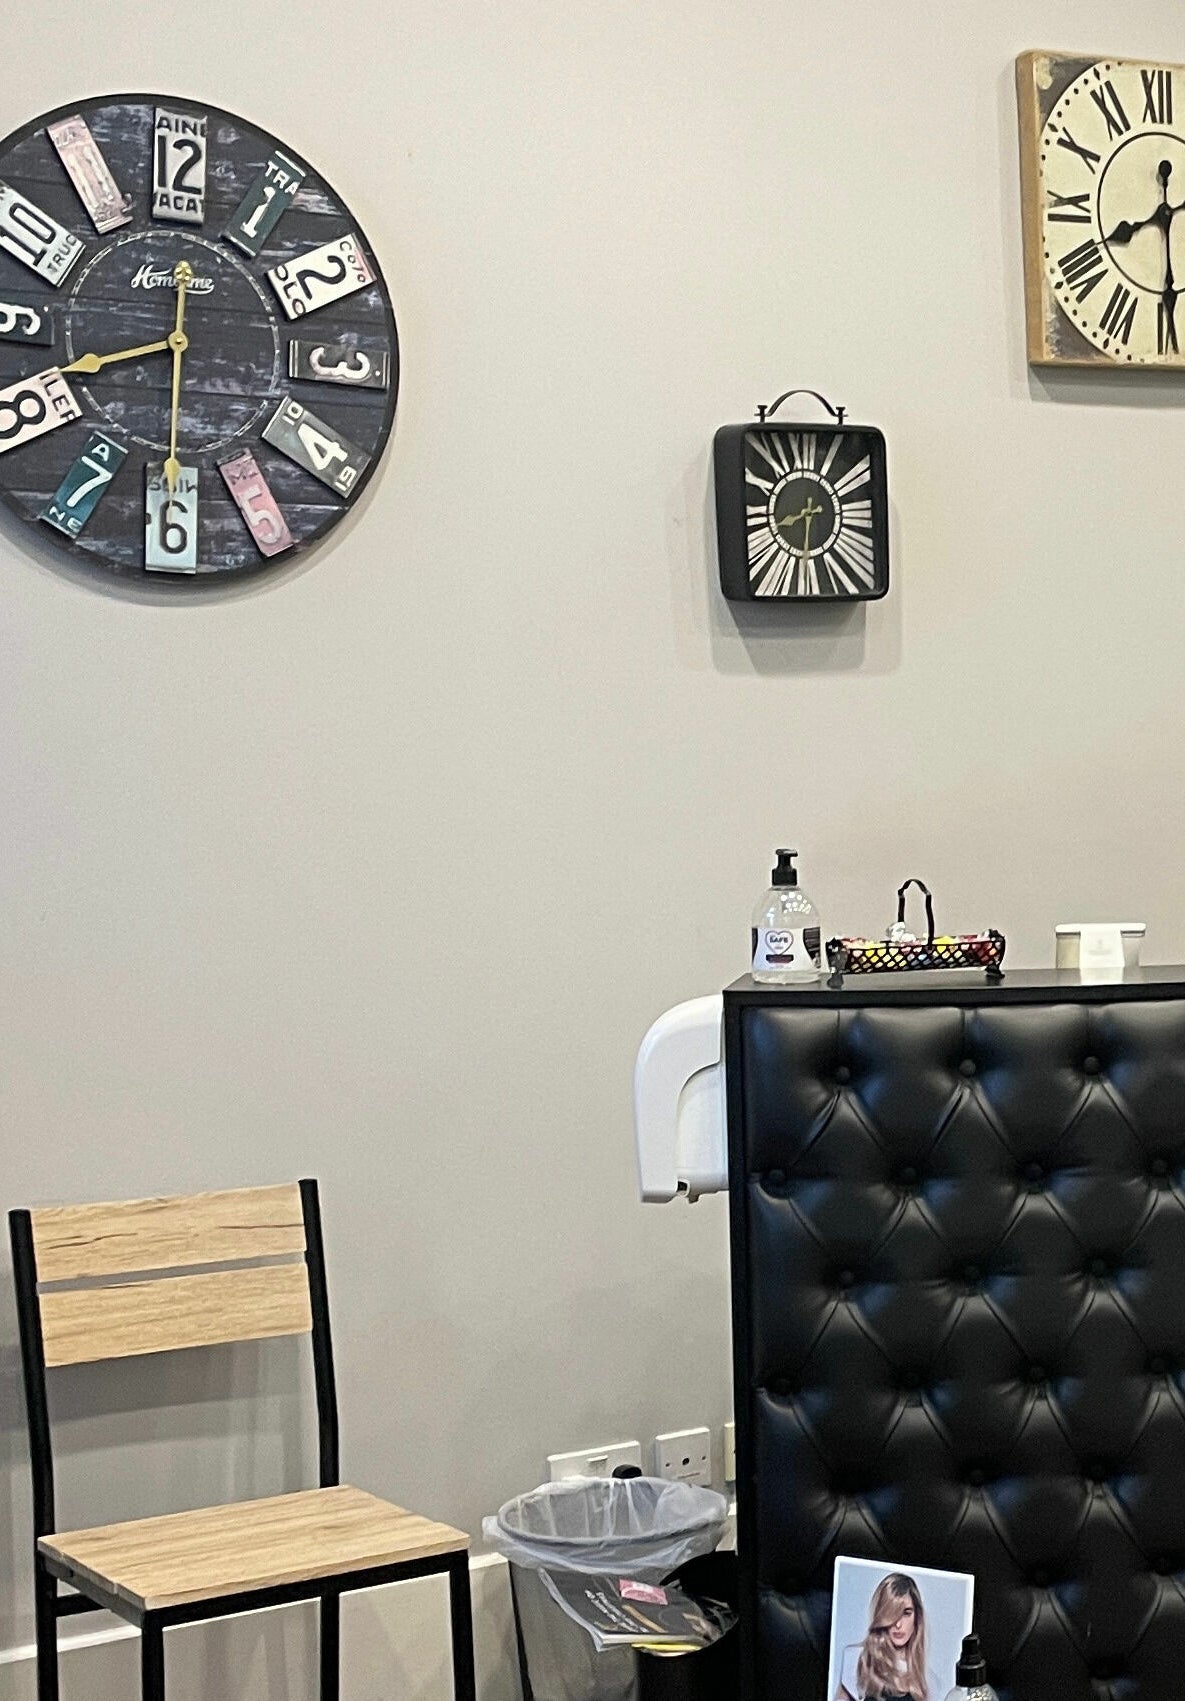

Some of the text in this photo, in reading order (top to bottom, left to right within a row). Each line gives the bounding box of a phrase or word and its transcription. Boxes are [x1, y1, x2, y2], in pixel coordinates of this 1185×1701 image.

[157, 134, 202, 195] 12
[264, 160, 301, 195] TRA
[0, 202, 57, 268] 10
[239, 186, 276, 238] 1
[296, 255, 347, 300] 2
[309, 346, 371, 380] 3
[0, 389, 46, 439] 8
[298, 423, 348, 471] 4
[81, 455, 113, 508] 7
[159, 499, 188, 554] 6
[239, 484, 282, 544] 5
